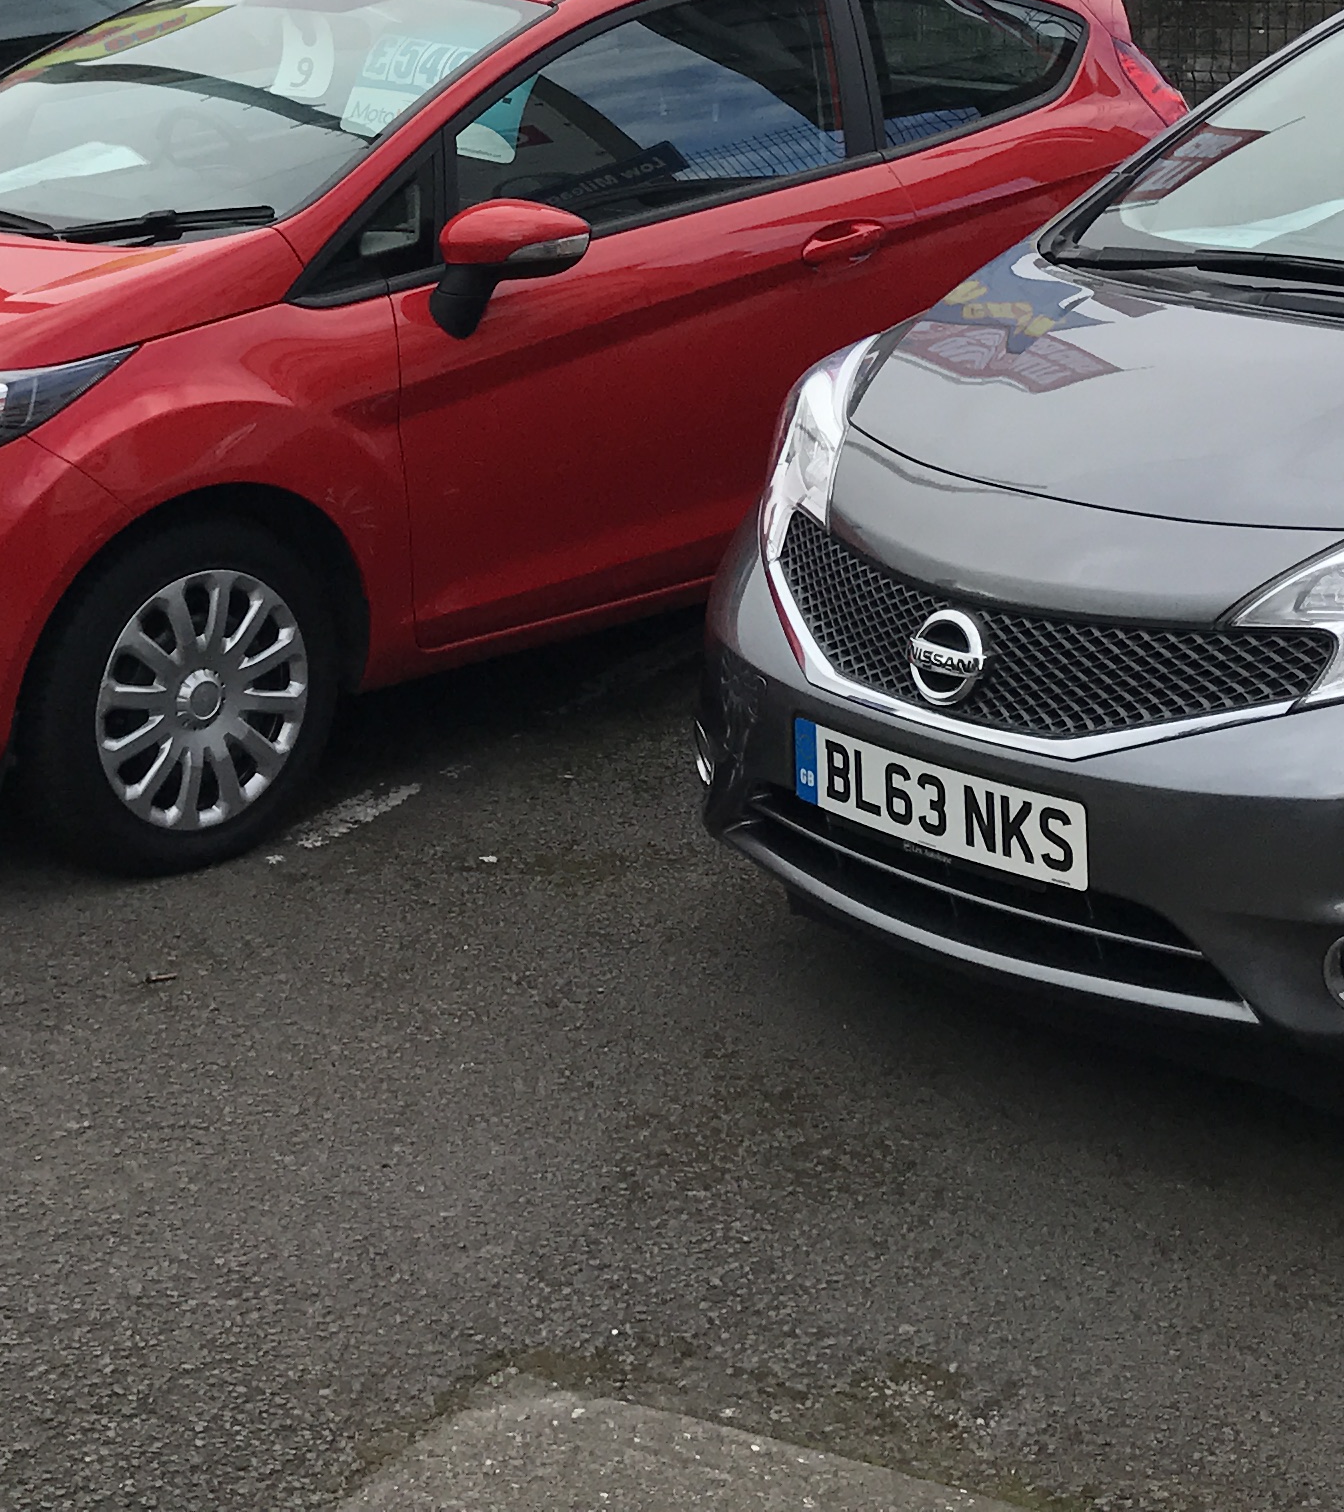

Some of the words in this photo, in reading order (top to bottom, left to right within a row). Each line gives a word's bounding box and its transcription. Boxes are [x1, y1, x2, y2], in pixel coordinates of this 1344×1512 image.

[908, 644, 987, 674] NISSAN
[799, 767, 815, 787] GB
[824, 738, 947, 837] BL63
[963, 784, 1074, 873] NKS
